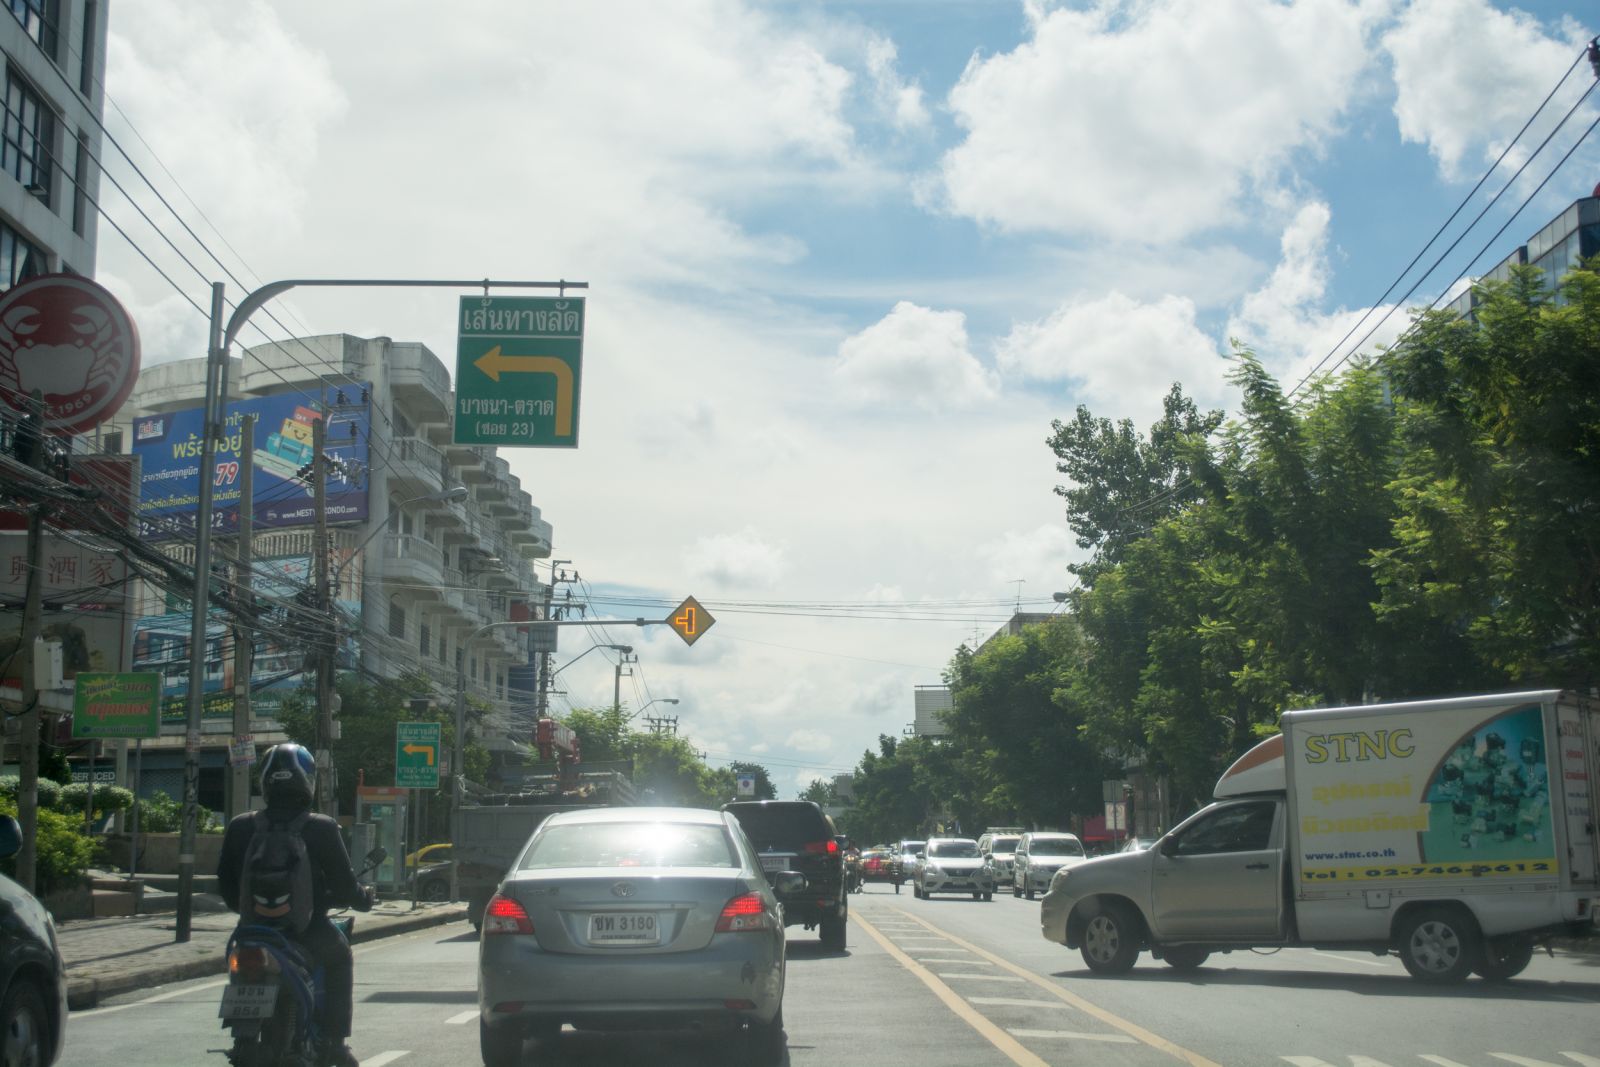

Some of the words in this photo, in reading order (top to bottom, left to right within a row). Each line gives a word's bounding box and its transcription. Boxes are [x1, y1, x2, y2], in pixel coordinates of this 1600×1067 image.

[464, 298, 579, 331] เส้นทางลัด
[59, 394, 92, 414] 1969
[461, 398, 554, 416] บางนา-ตราด
[512, 422, 535, 437] 23)
[1304, 728, 1416, 764] STNC
[72, 771, 115, 781] SERICED
[1305, 848, 1396, 861] www.stnc.co.th
